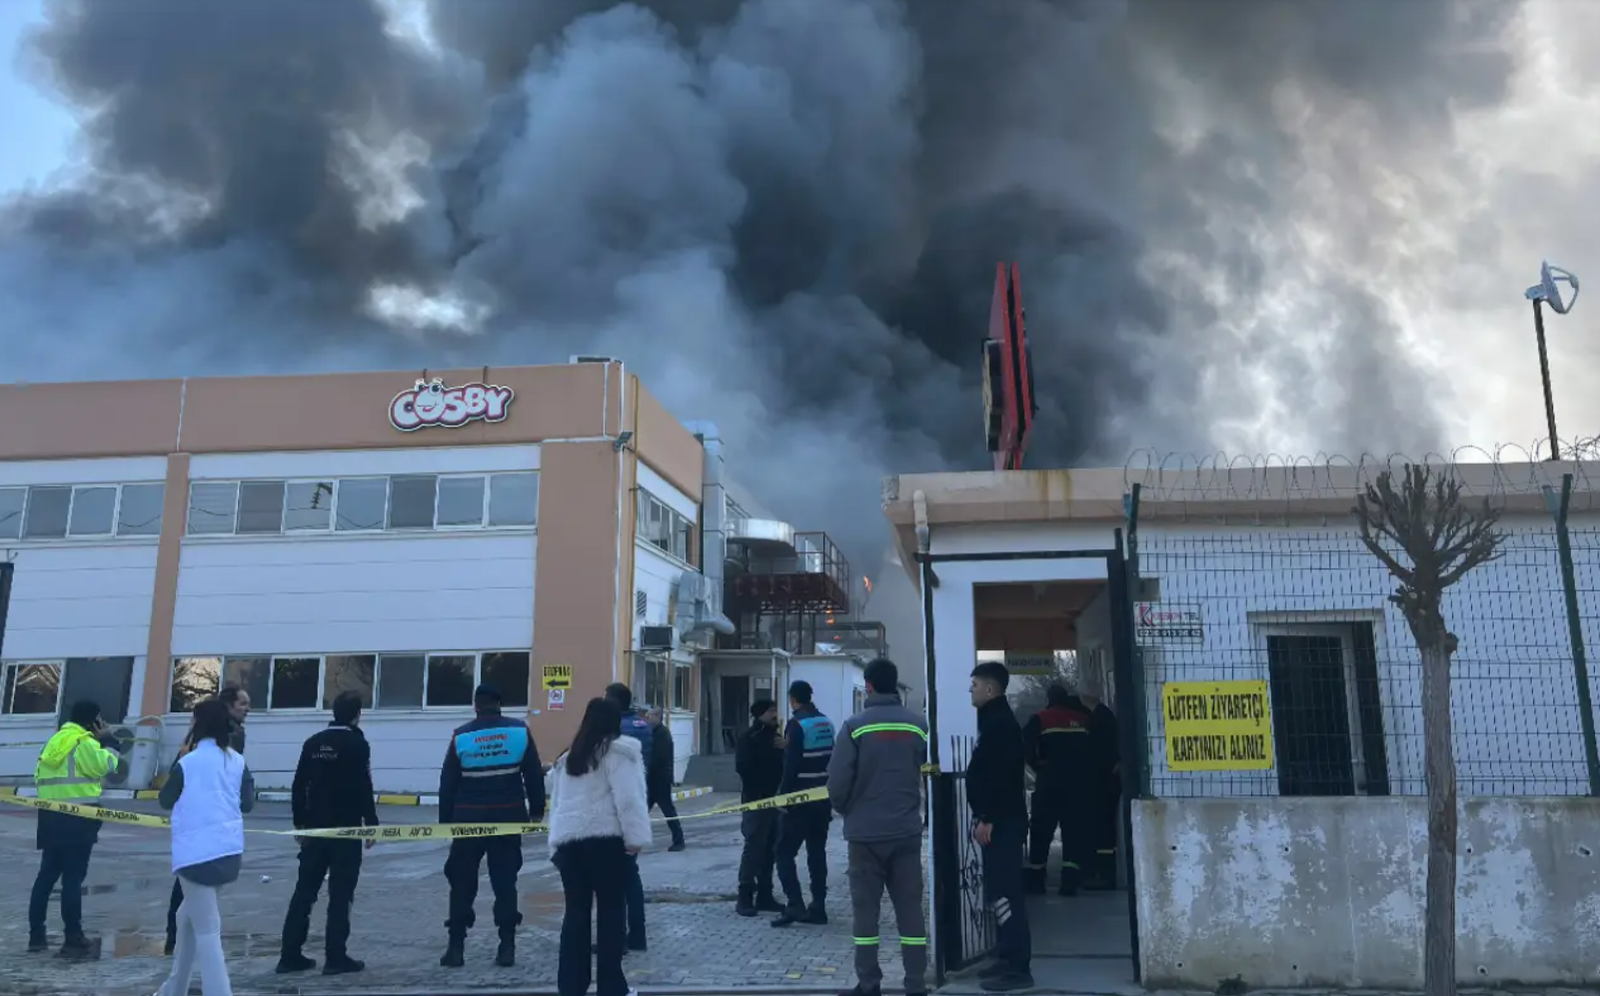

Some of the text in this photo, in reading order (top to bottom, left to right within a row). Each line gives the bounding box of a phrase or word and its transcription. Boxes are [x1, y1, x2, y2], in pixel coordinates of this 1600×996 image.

[391, 382, 512, 430] COSBY
[1167, 687, 1265, 726] LÜTFEN ZİYARETÇİ
[1172, 734, 1267, 762] KARTINIZI ALINIZ
[409, 826, 433, 837] OLAY
[451, 825, 498, 836] JANDARMA
